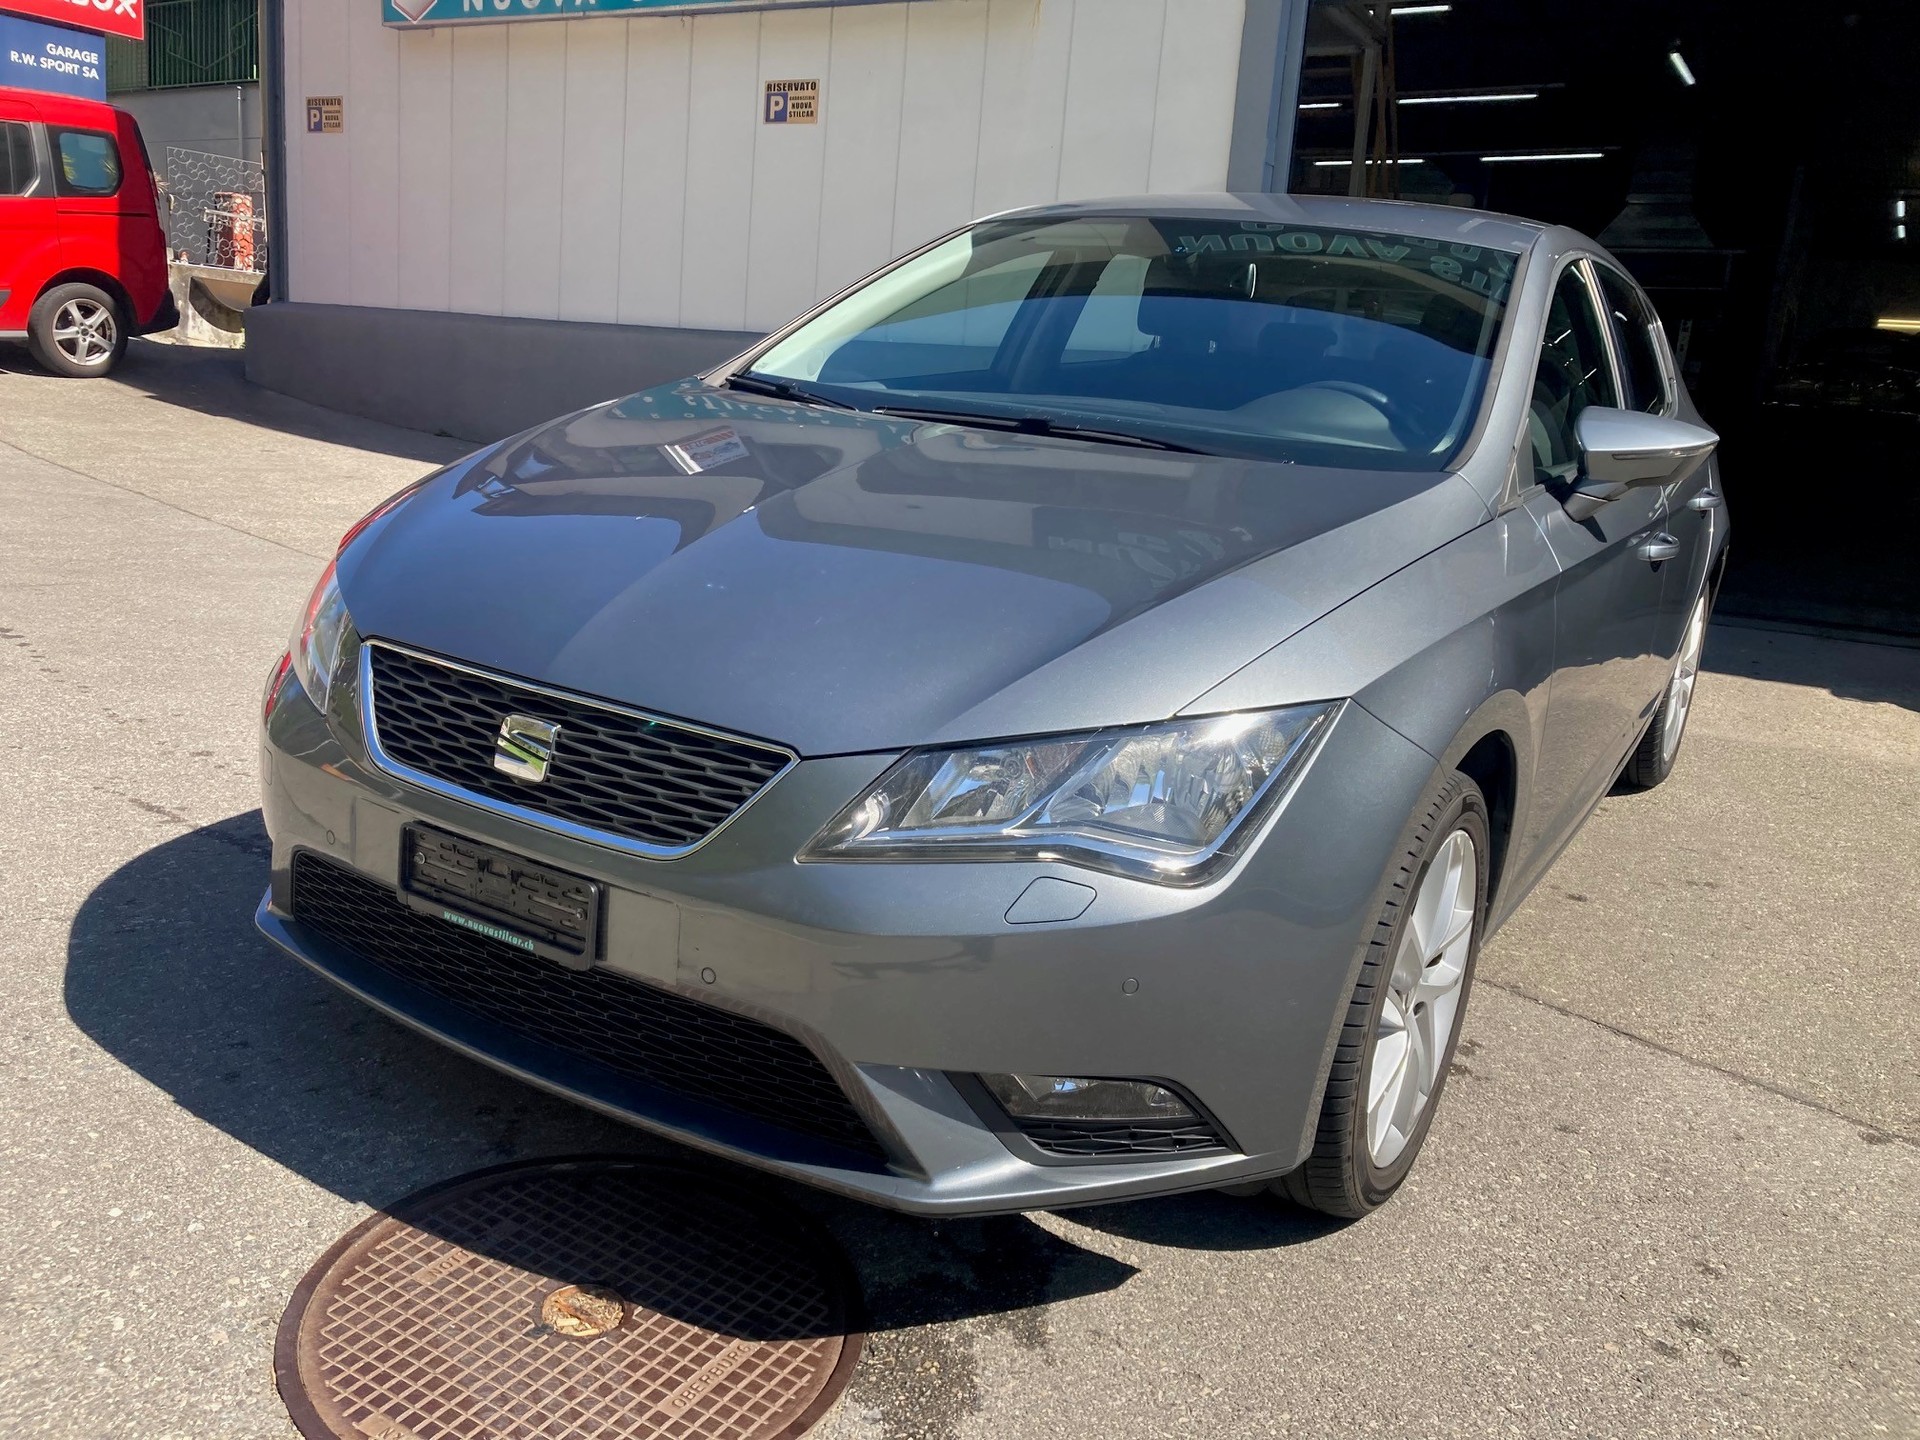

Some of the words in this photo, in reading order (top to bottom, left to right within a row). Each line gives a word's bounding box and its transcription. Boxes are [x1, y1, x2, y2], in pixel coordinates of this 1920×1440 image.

[46, 43, 99, 65] GARAGE
[10, 50, 37, 67] R.W.
[40, 57, 80, 76] SPORT
[82, 66, 99, 80] SA
[766, 81, 817, 92] RISERVATO
[307, 98, 342, 107] RISERVATO
[769, 95, 785, 119] P
[791, 101, 812, 110] NUOVA
[310, 109, 320, 129] P
[788, 110, 815, 118] STILCAR
[443, 910, 535, 952] www.nuovastilcar.ch
[671, 1344, 751, 1408] OBERBURG
